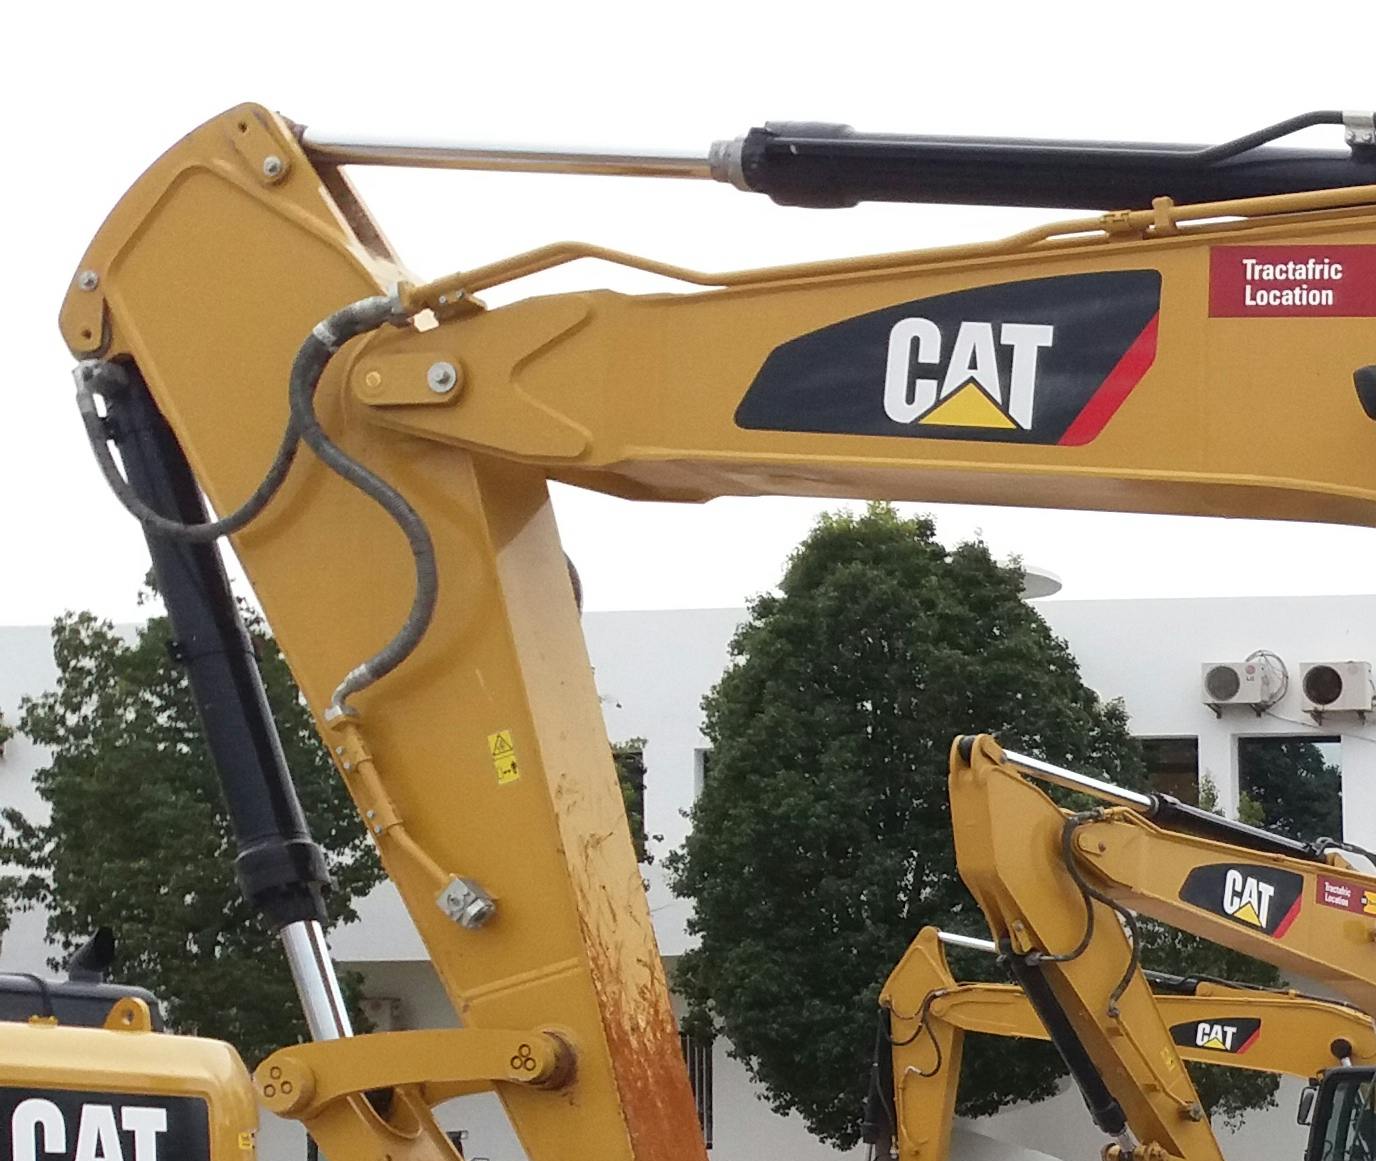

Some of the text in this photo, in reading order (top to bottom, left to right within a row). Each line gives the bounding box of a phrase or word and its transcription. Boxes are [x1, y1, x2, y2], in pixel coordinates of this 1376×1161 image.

[1243, 258, 1343, 281] Tractafric
[1245, 285, 1333, 306] Location
[884, 317, 1054, 430] CAT
[1223, 869, 1274, 928] CAT
[1324, 892, 1349, 907] Location
[1196, 1022, 1237, 1051] CAT
